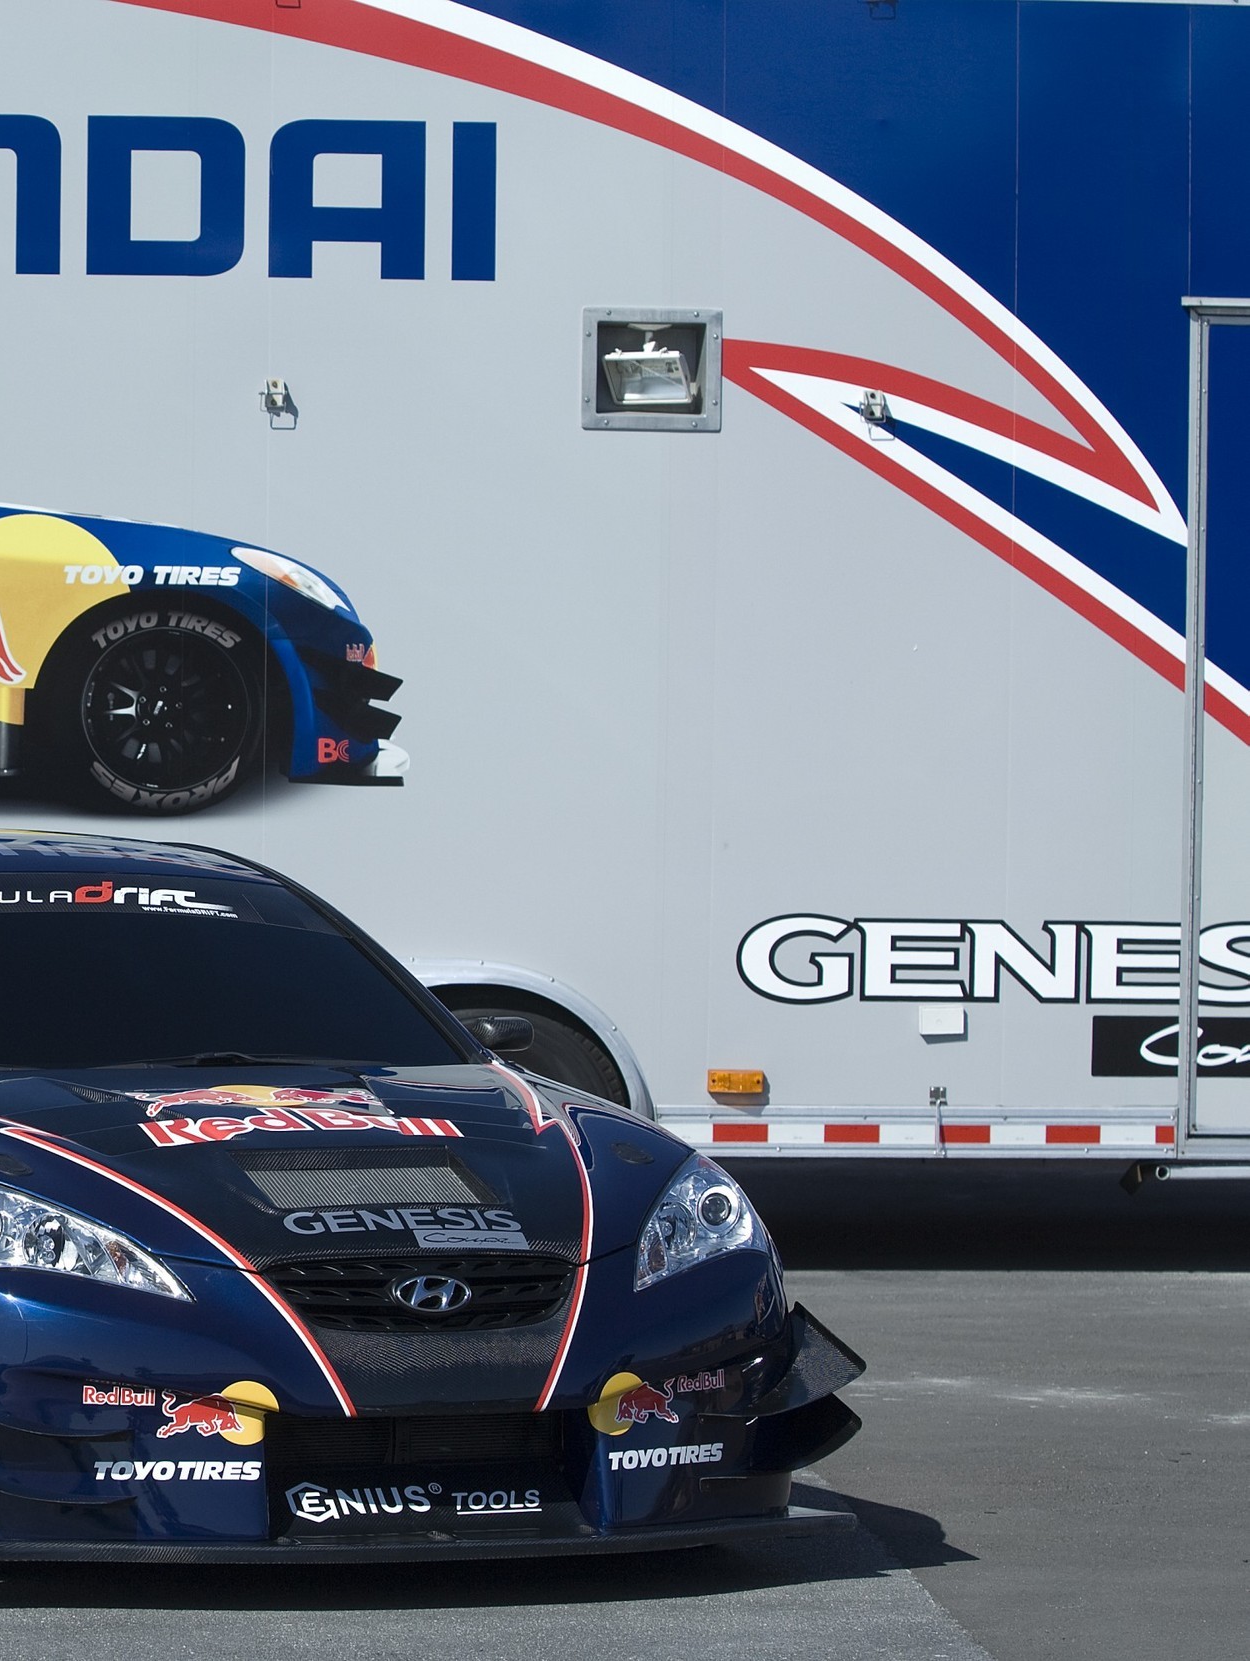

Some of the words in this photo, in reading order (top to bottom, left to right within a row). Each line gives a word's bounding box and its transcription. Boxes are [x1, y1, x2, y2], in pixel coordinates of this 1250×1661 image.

[64, 565, 144, 585] TOYO
[153, 566, 242, 587] TIRES
[91, 611, 159, 649] TOYO
[167, 610, 242, 649] TIRES
[89, 756, 240, 809] PROXES
[137, 1107, 315, 1147] Red
[297, 1107, 465, 1137] Bull
[283, 1208, 521, 1235] GENESIS
[677, 1372, 702, 1393] Red
[703, 1369, 725, 1390] Bull
[82, 1385, 119, 1406] Red
[120, 1387, 156, 1407] Bull
[608, 1447, 667, 1471] TOYO
[668, 1442, 724, 1465] TIRES
[93, 1461, 175, 1481] TOYO
[176, 1461, 262, 1481] TIRES
[451, 1489, 541, 1511] TOOLS
